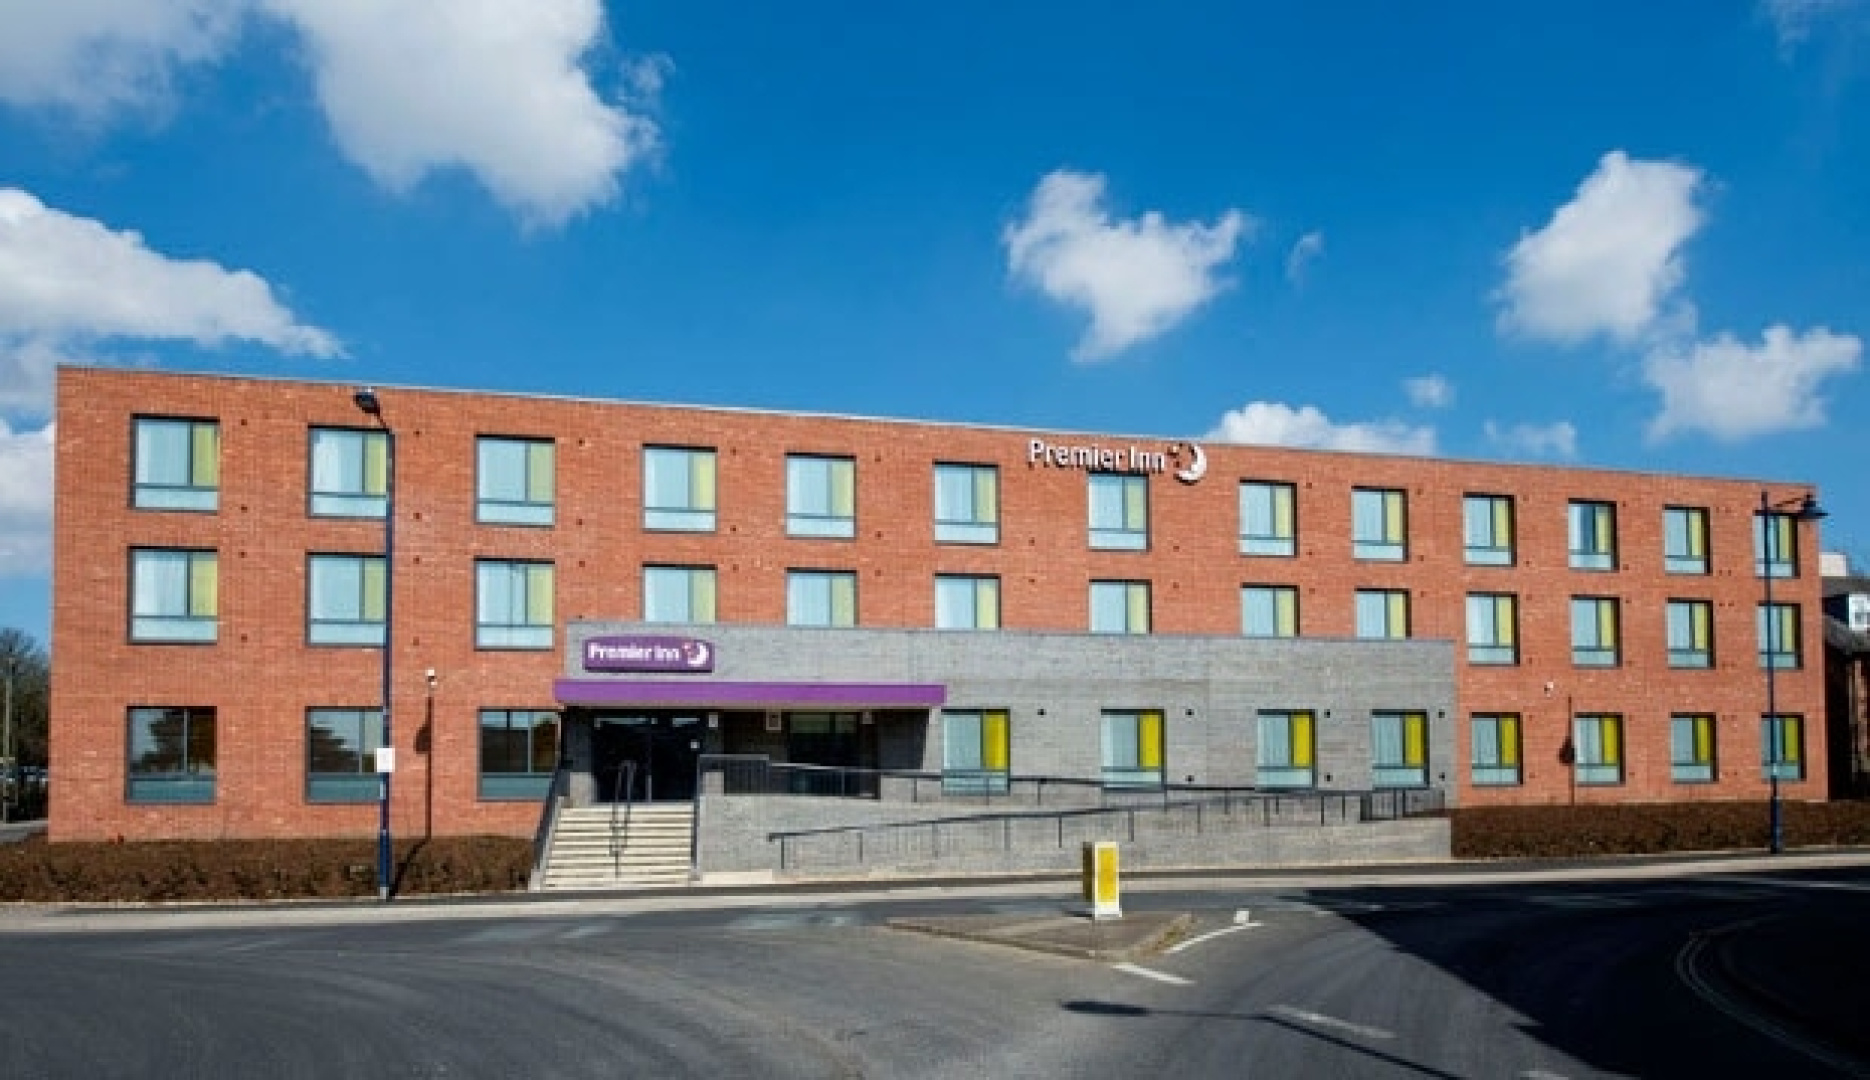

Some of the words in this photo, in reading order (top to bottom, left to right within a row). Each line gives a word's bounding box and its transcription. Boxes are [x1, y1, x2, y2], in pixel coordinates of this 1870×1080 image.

[1029, 437, 1126, 469] Premier
[1129, 445, 1166, 471] Inn
[587, 642, 652, 661] Premier
[654, 643, 680, 662] Inn
